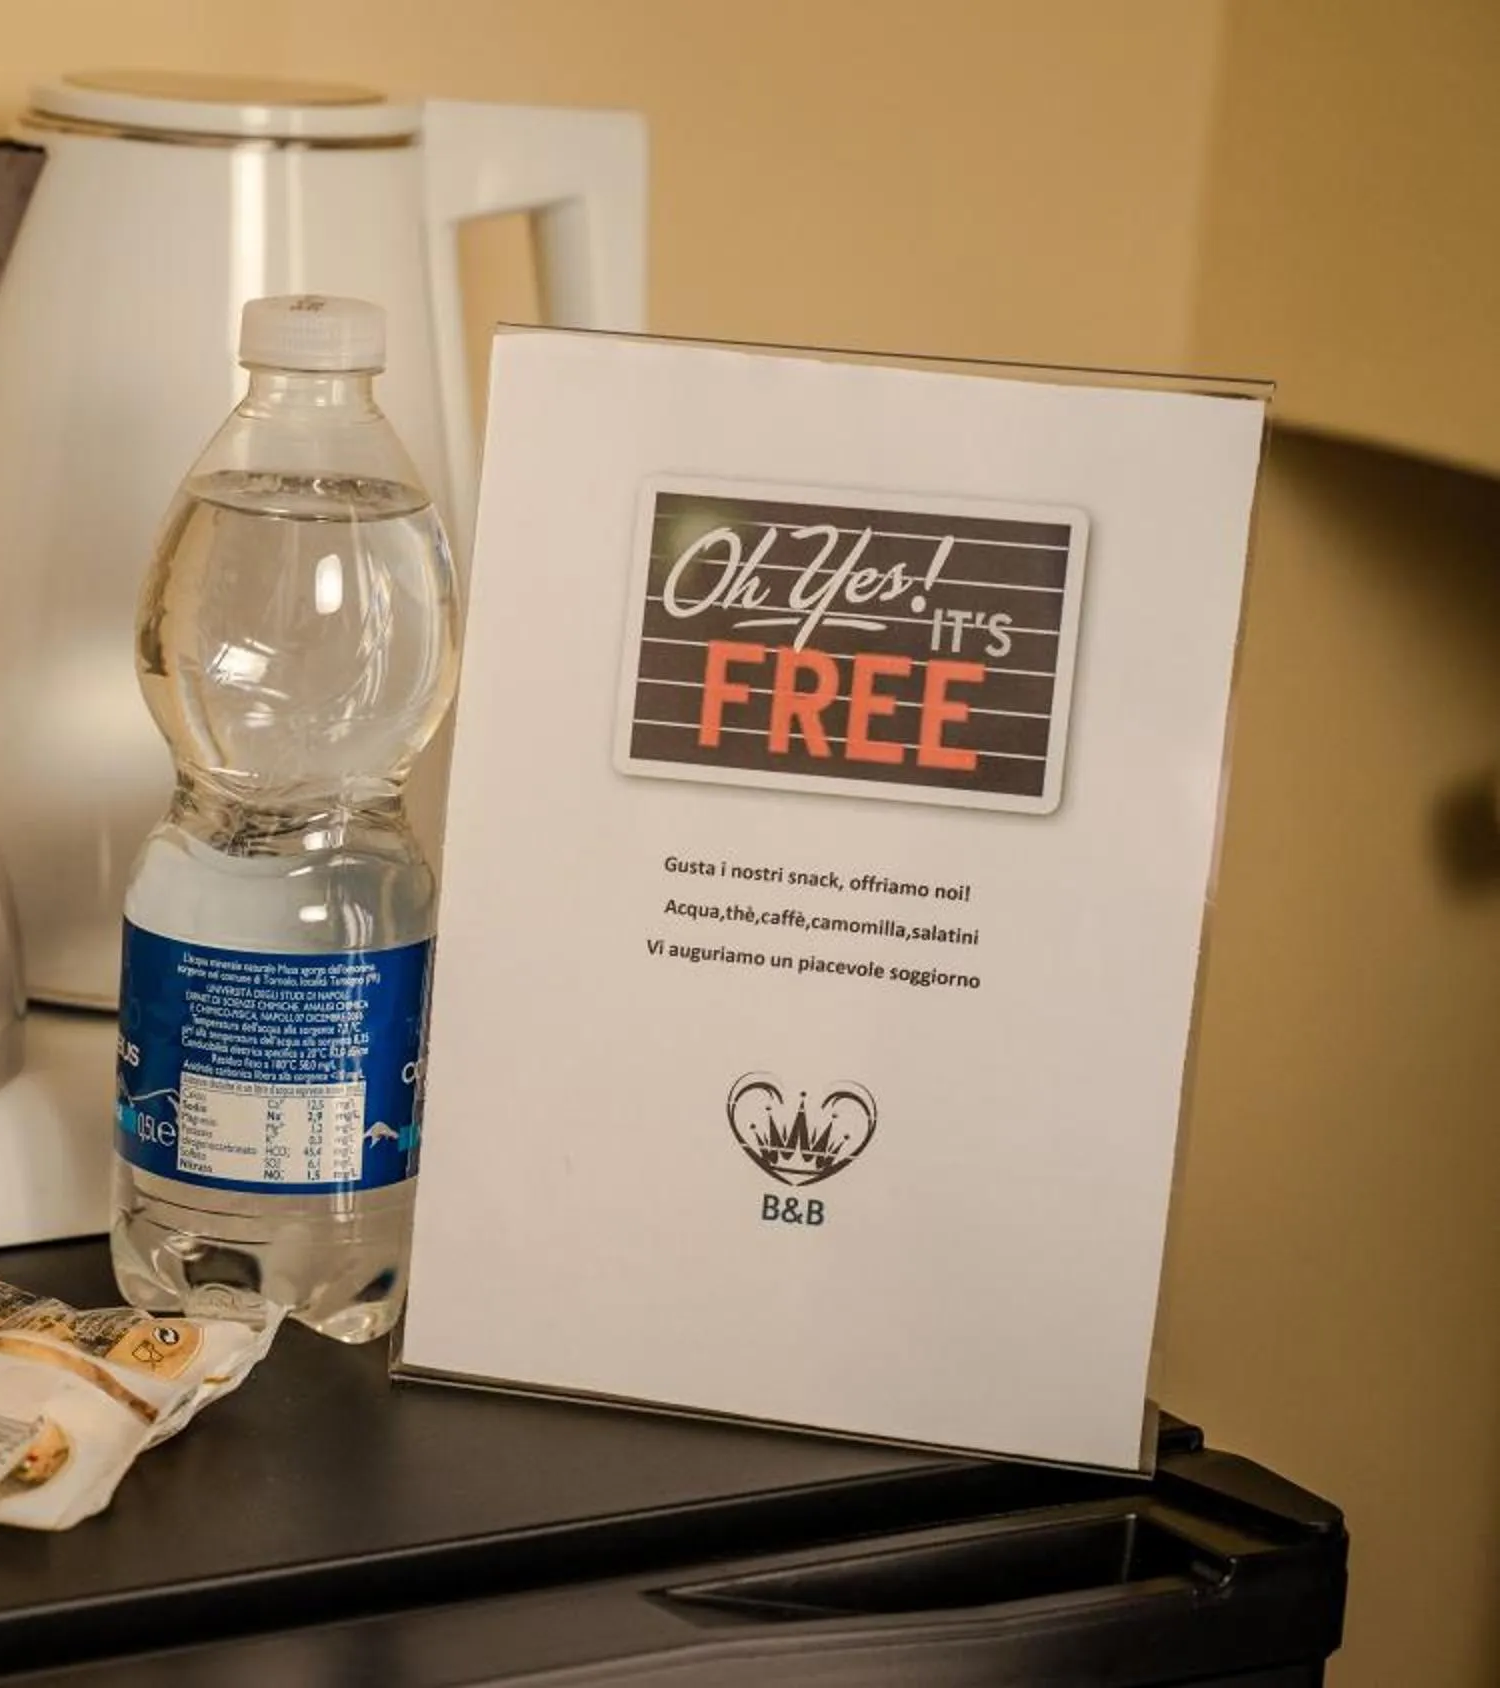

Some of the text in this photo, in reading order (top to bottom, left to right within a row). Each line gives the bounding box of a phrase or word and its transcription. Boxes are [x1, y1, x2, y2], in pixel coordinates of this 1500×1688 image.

[663, 525, 955, 652] Oh Yes!
[931, 608, 1013, 657] IT'S
[698, 639, 986, 771] FREE
[664, 856, 971, 902] Gusta i nostri snack, offriamo noi!
[647, 939, 981, 989] Vi auguriamo un piacevole soggiorno
[761, 1193, 825, 1226] B&B
